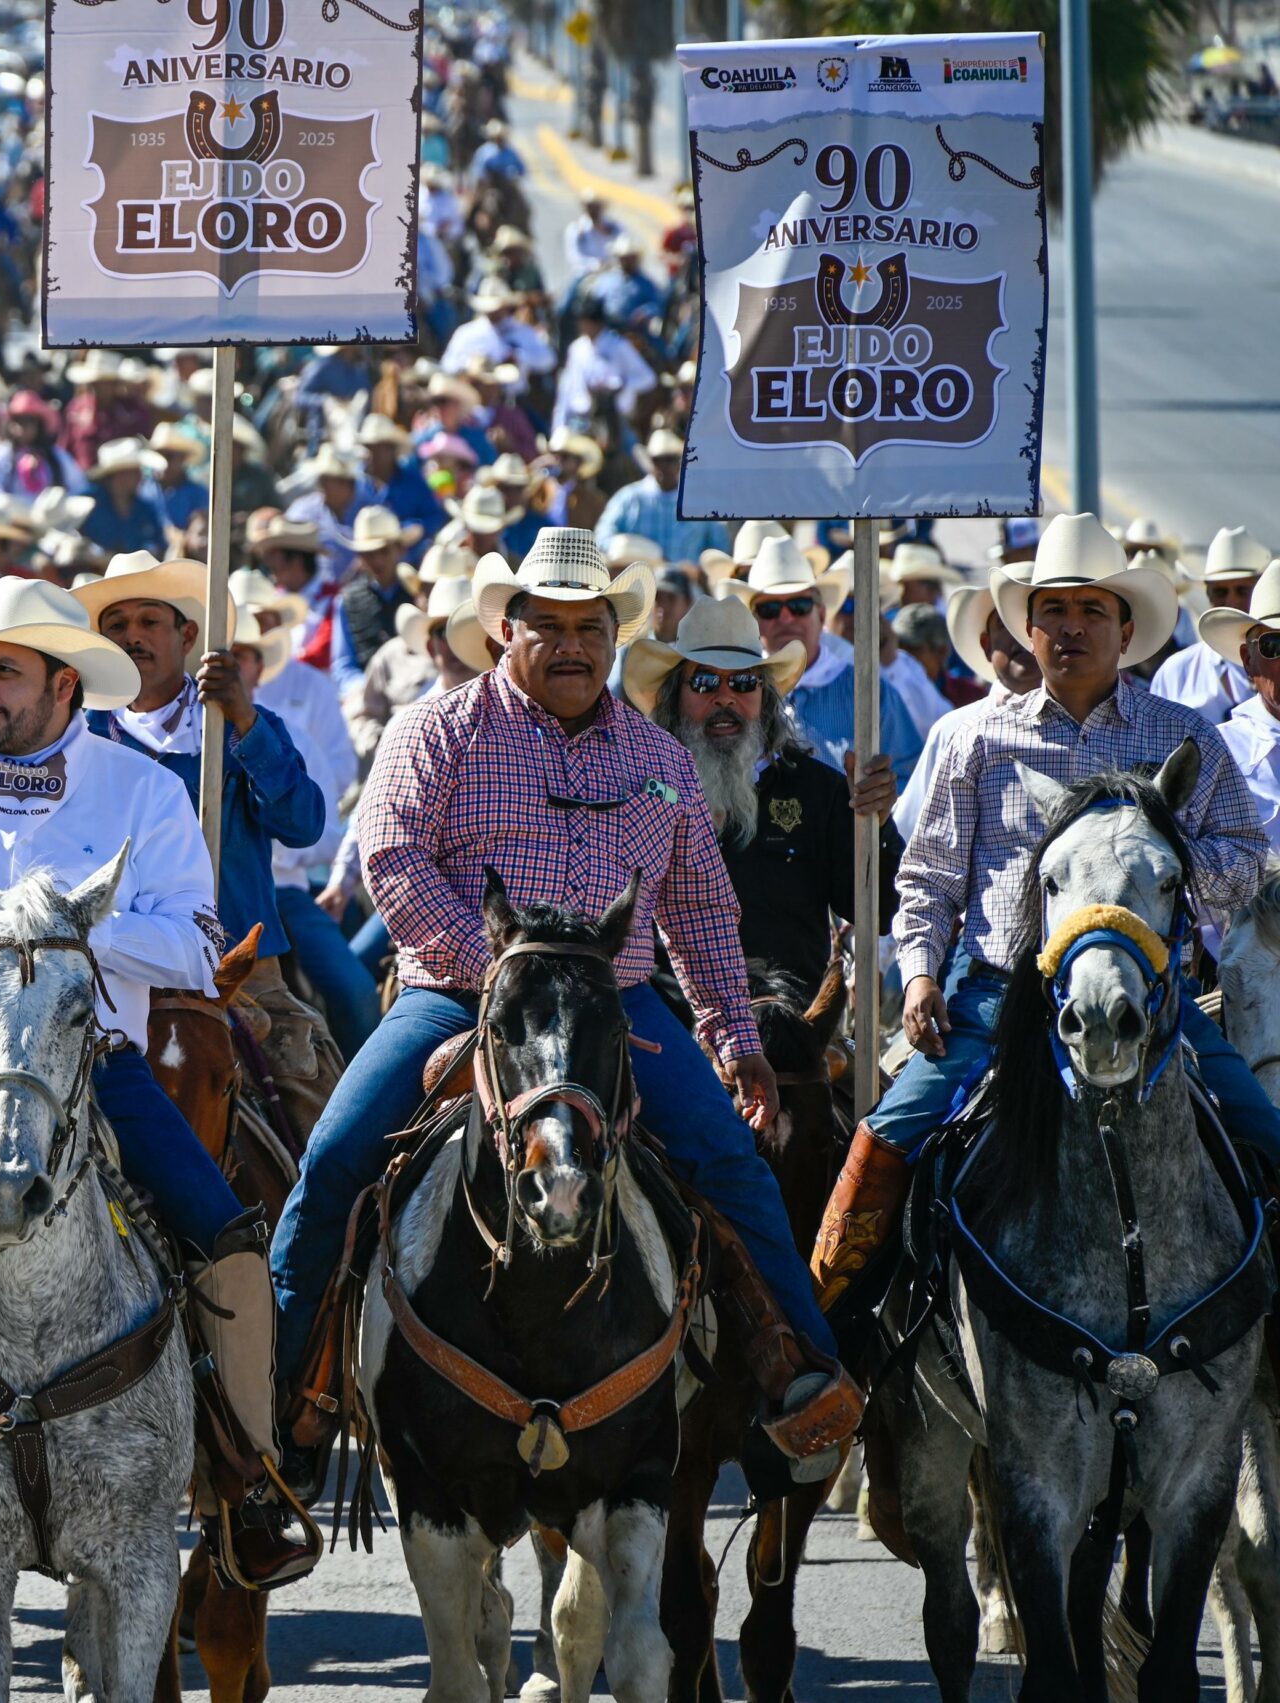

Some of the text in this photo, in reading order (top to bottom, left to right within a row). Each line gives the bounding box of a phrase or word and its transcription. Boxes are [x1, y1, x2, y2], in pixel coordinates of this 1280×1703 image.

[188, 0, 285, 51] 90
[122, 53, 351, 89] ANIVERSARIO
[700, 67, 796, 89] COAHUILA
[869, 84, 921, 92] MONCLOVA
[130, 132, 166, 147] 1935
[298, 132, 335, 147] 2025
[161, 159, 305, 200] EJIDO
[814, 143, 913, 214] 90
[763, 214, 980, 252] ANIVERSARIO
[763, 296, 797, 312] 1935
[926, 295, 963, 310] 2025
[794, 324, 932, 367] EJIDO
